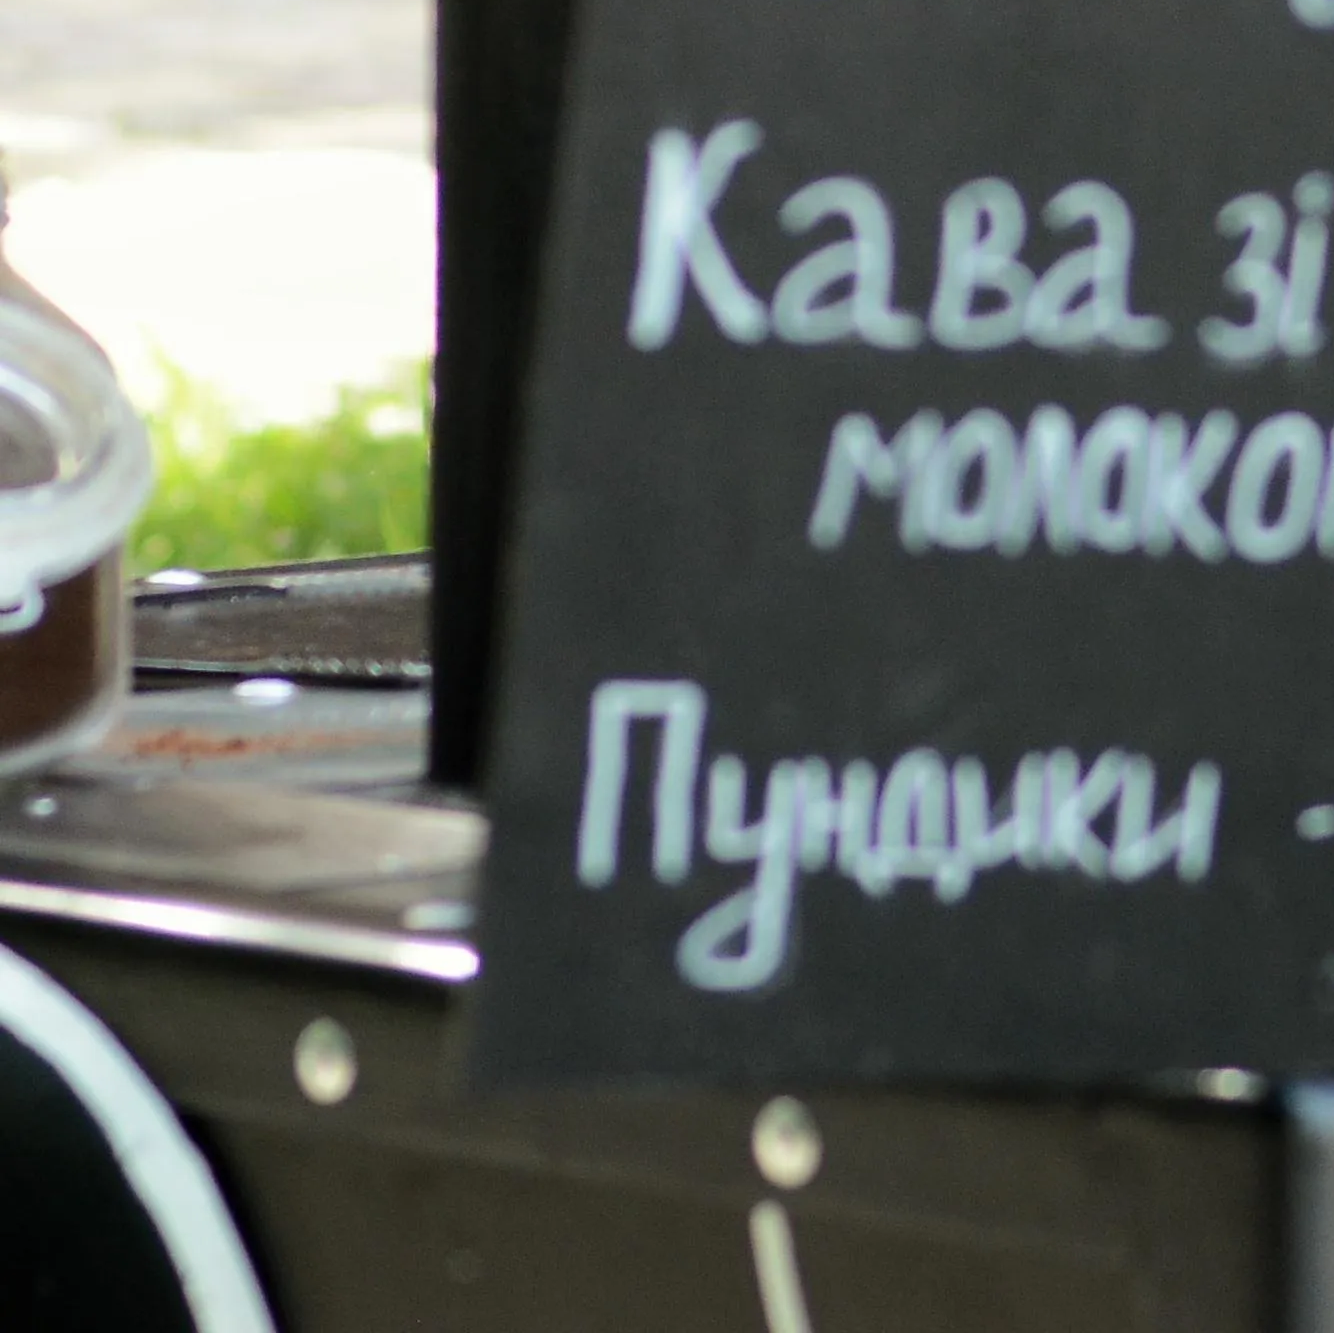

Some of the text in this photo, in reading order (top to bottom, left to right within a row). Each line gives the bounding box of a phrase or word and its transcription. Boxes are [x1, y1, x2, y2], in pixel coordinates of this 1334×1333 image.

[628, 119, 1166, 352] Кава
[1198, 171, 1334, 367] зі
[578, 680, 1220, 991] Пундики
